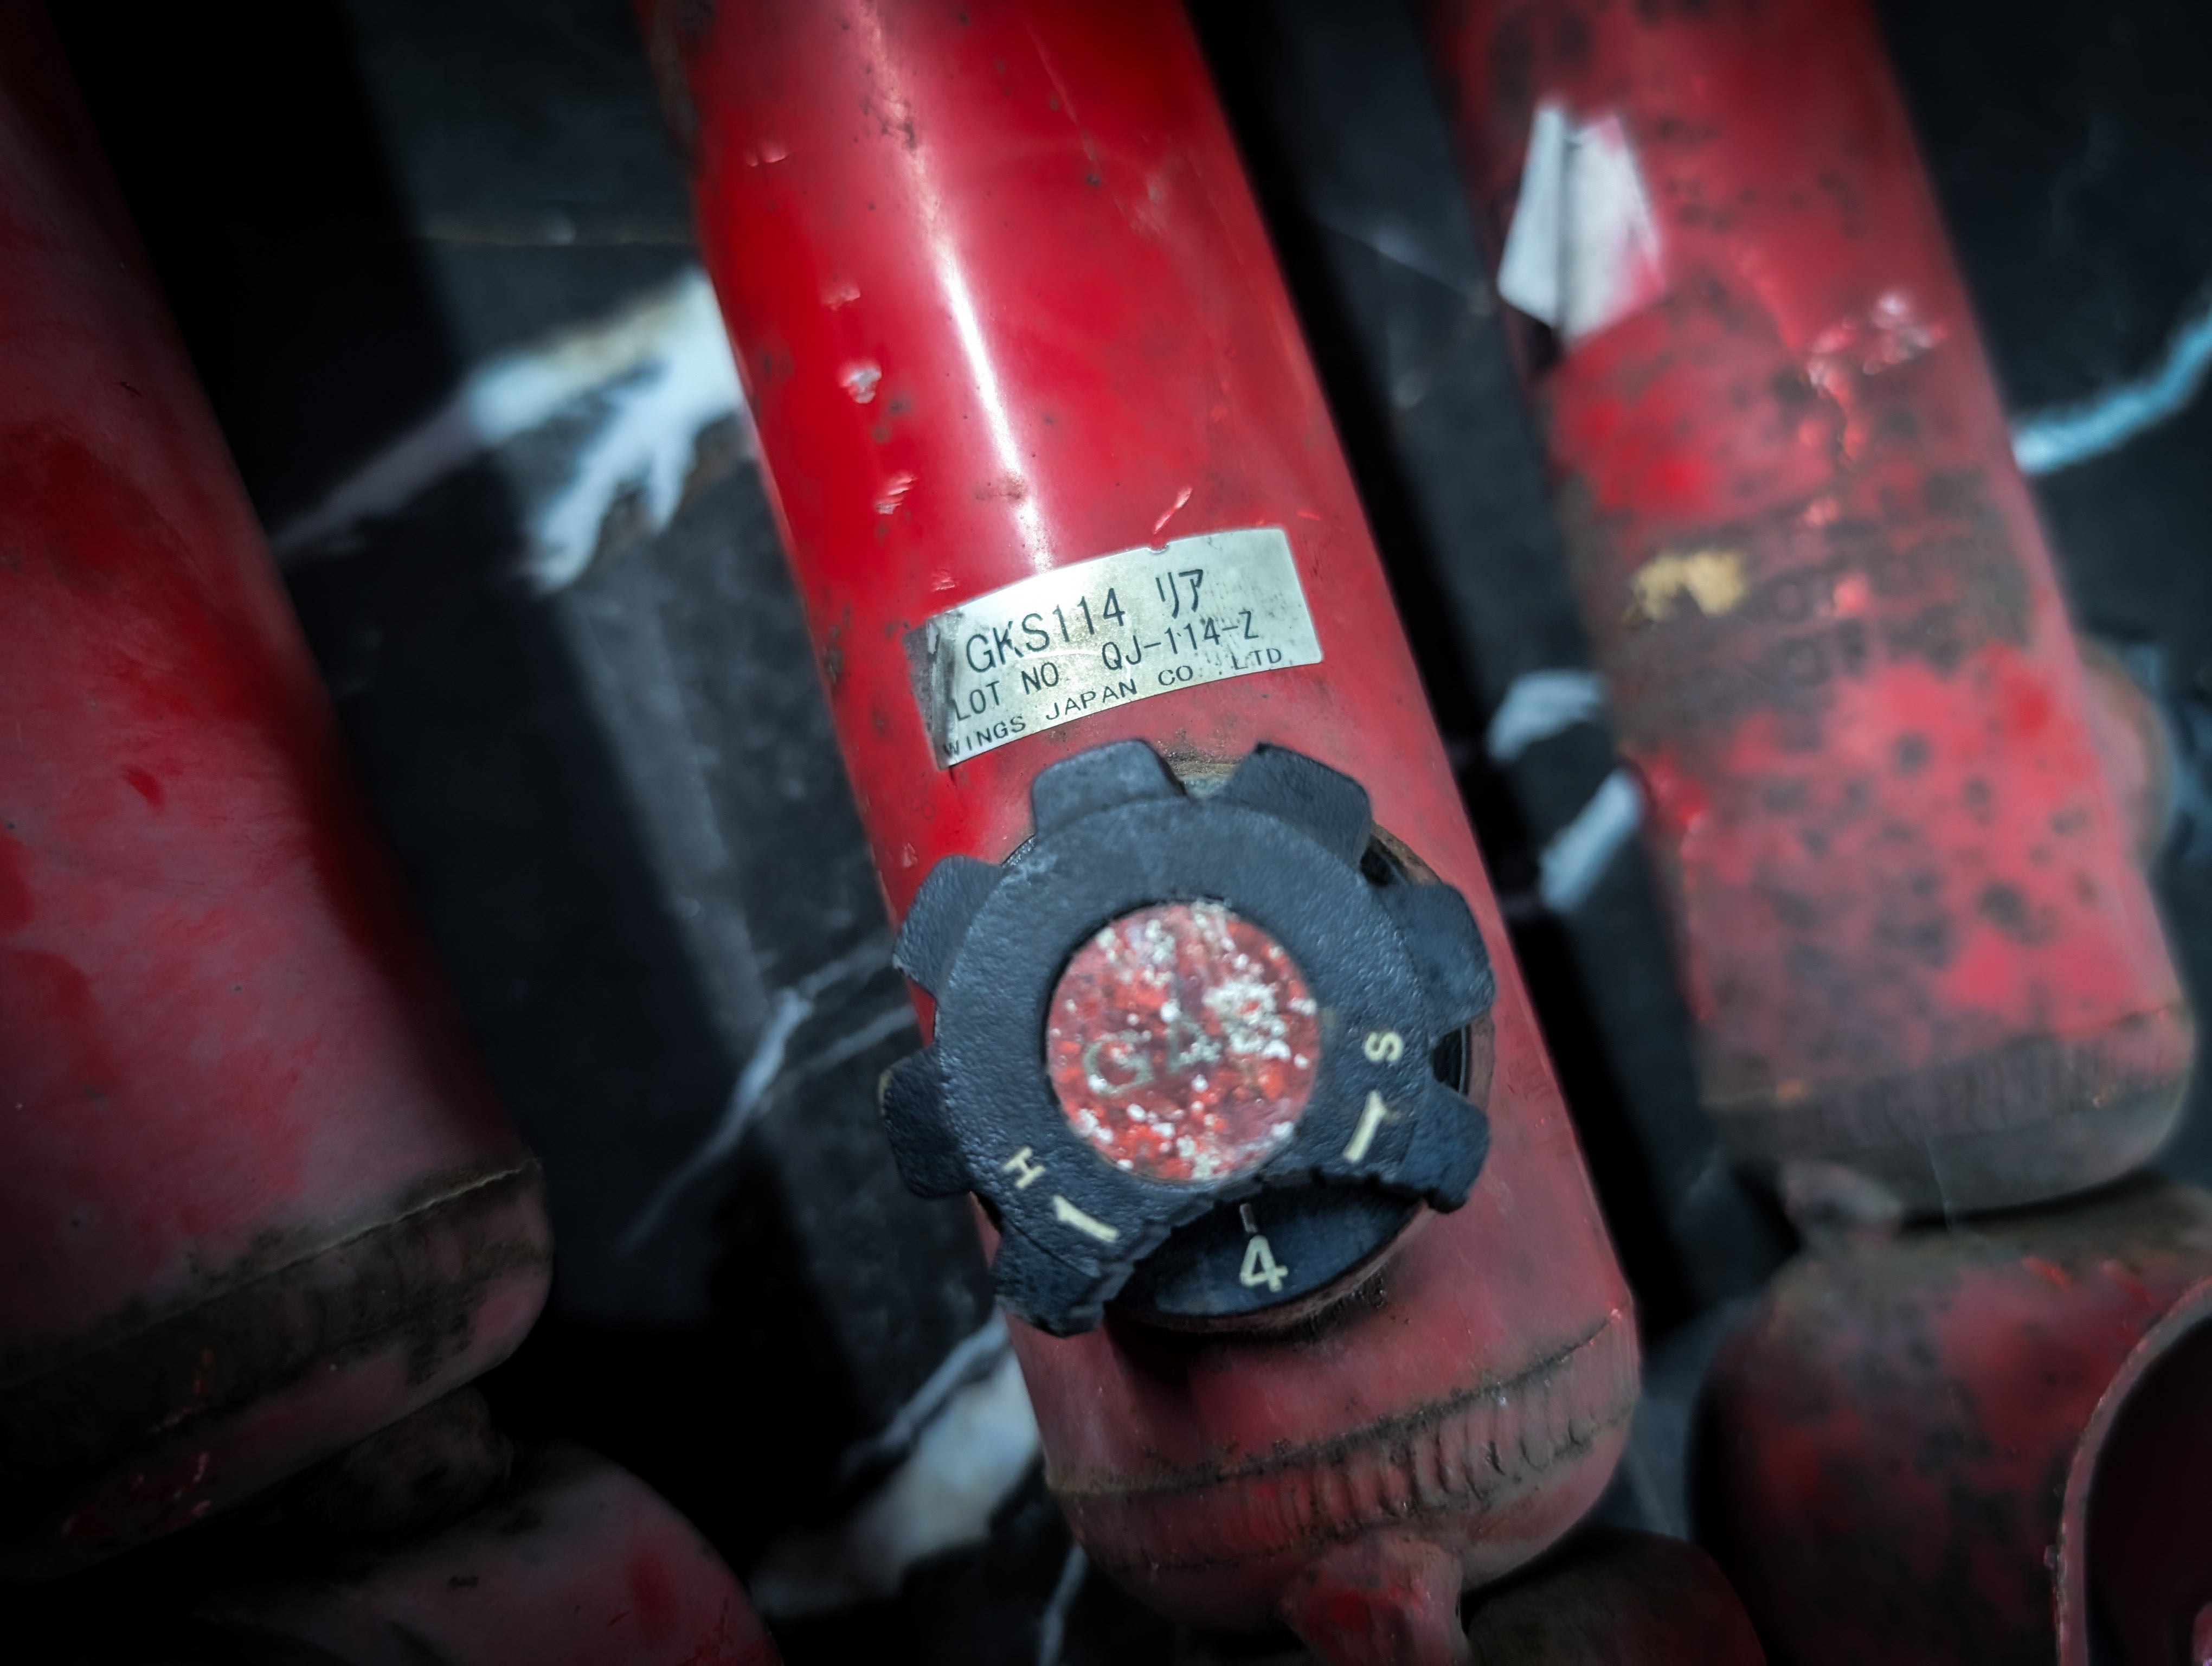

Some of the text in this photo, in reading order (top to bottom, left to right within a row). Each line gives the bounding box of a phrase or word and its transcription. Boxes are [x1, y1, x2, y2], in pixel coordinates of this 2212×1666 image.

[966, 568, 1204, 672] GKS114 リア
[943, 715, 1026, 758] WINGS
[1046, 678, 1137, 720] JAPAN
[951, 680, 1000, 721] LOT
[1021, 662, 1059, 695] NO
[1364, 1031, 1403, 1062] S
[1002, 1146, 1046, 1188] H
[1240, 1234, 1289, 1293] 4
